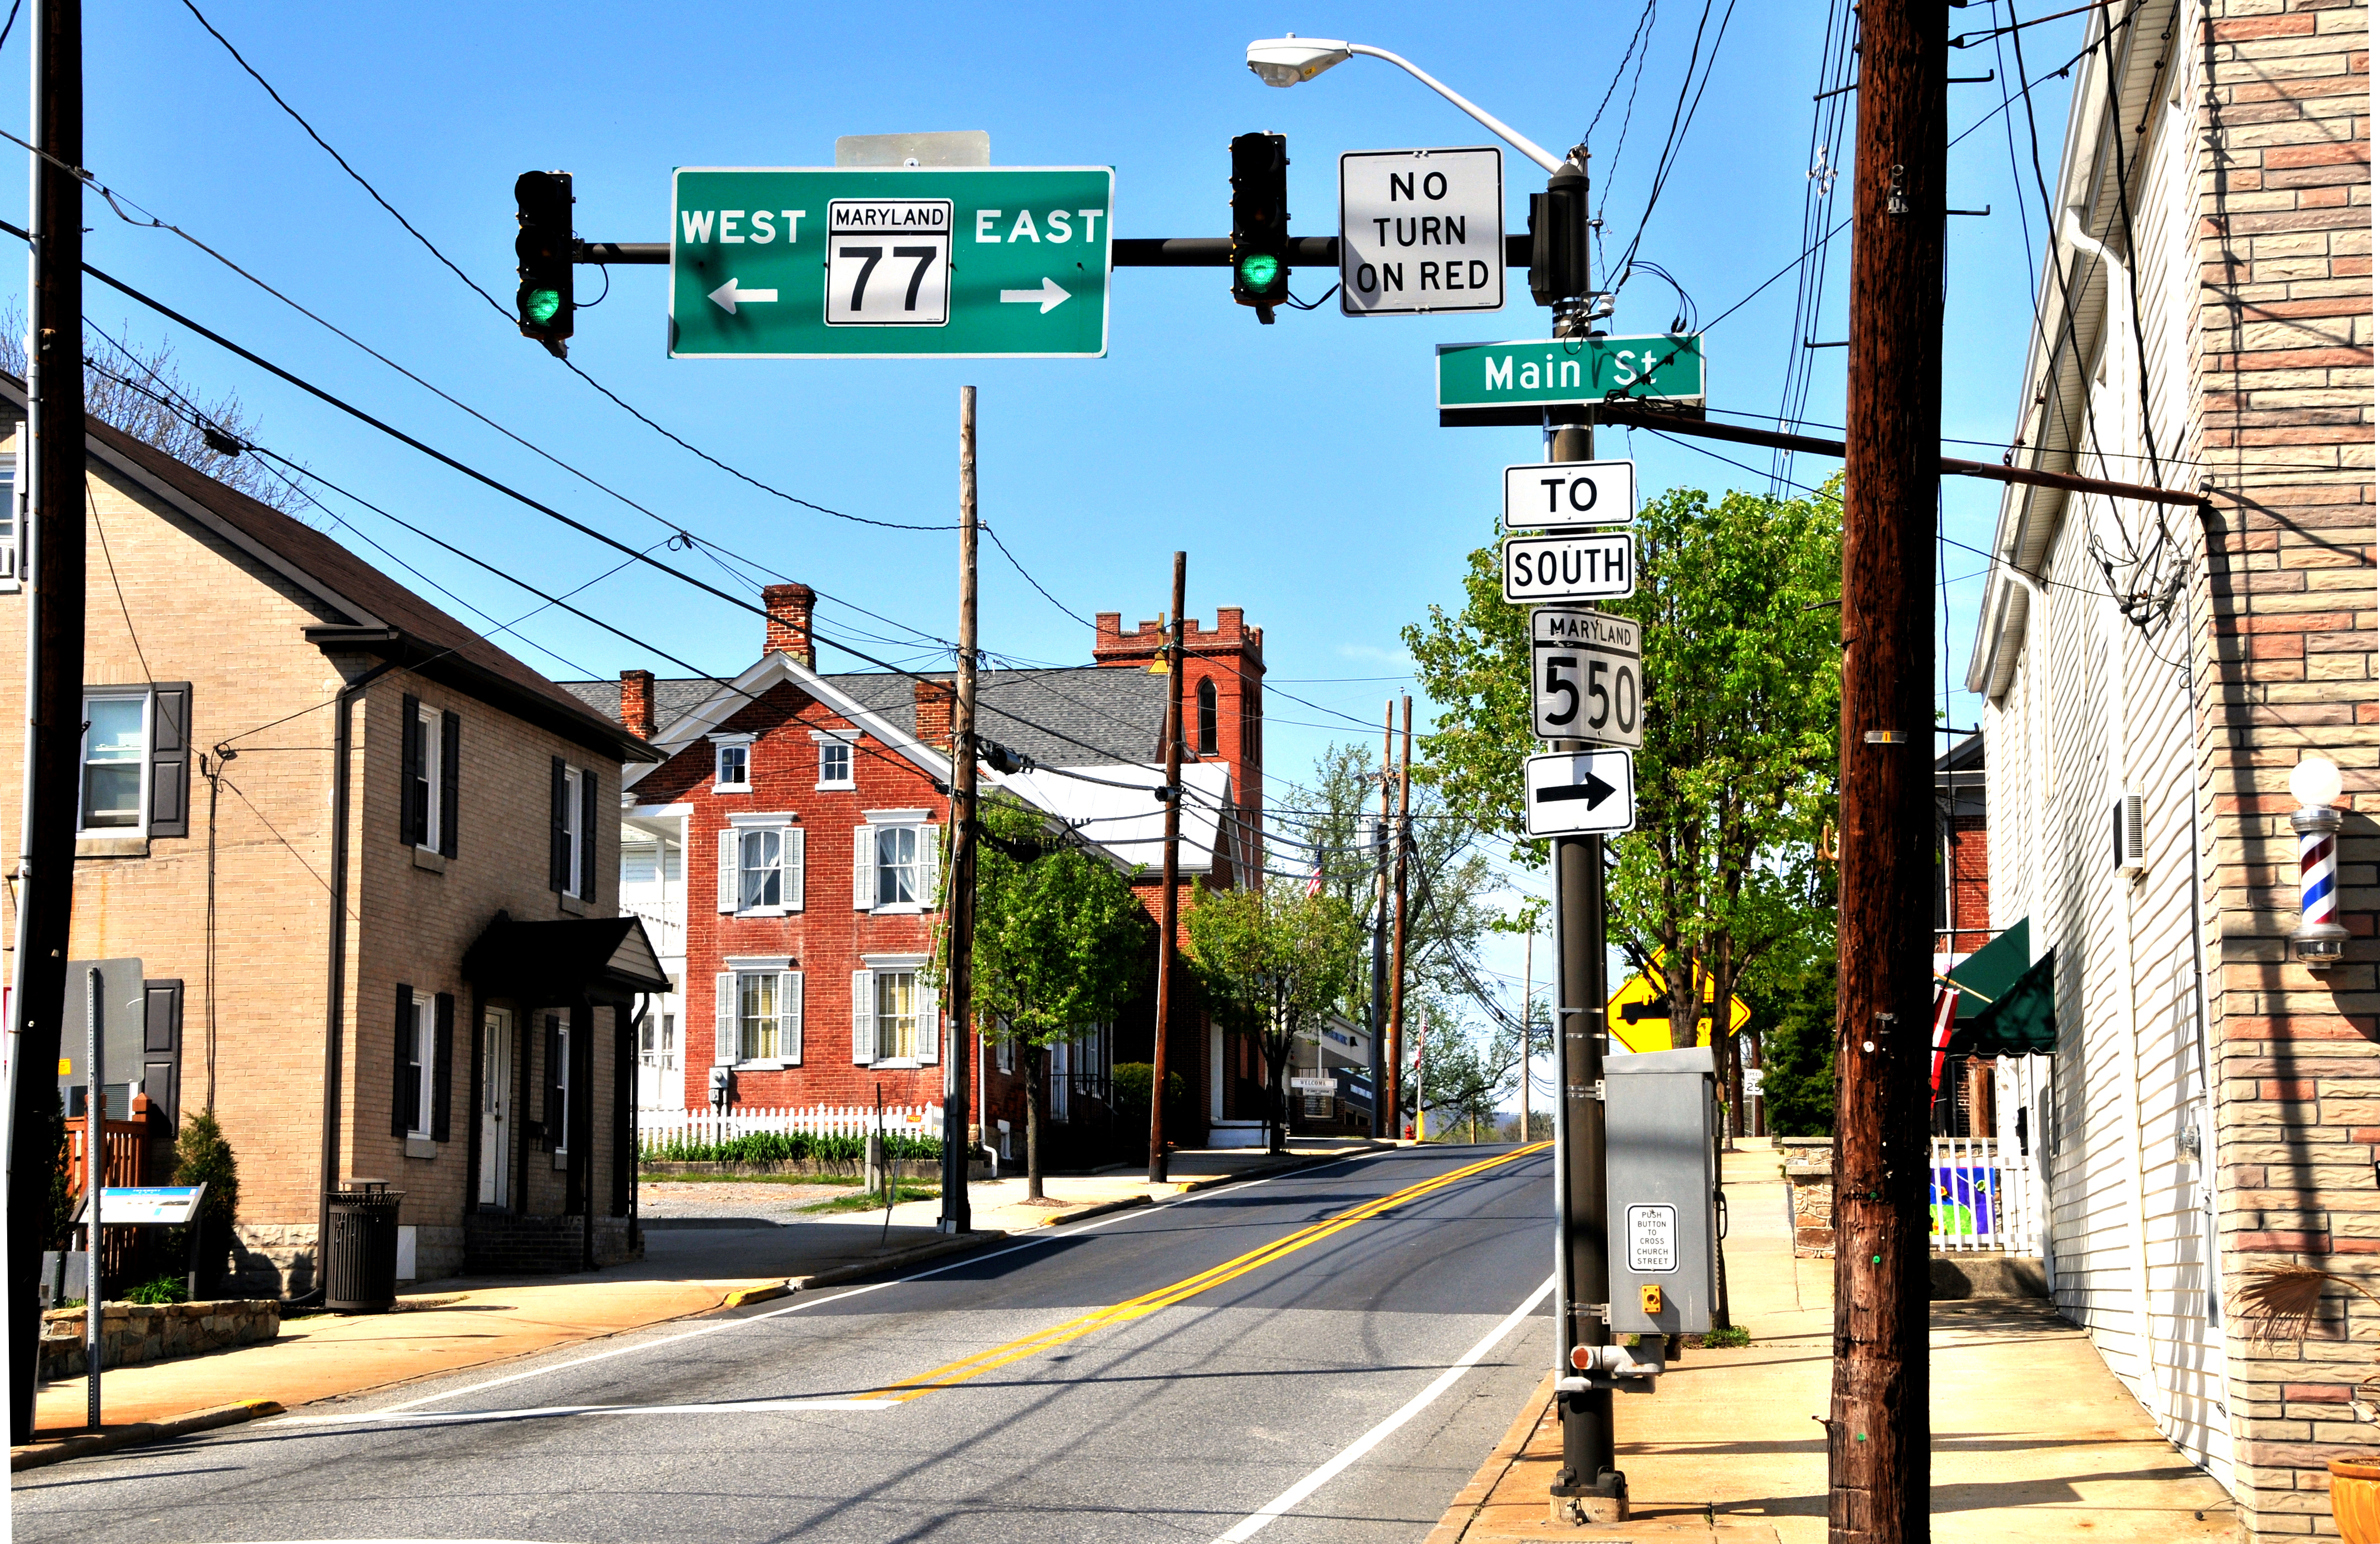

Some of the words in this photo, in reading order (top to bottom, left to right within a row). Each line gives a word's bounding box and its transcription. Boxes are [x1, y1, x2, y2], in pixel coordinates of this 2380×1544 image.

[1390, 172, 1448, 202] NO
[682, 210, 806, 244] WEST
[836, 208, 944, 226] MARYLAND
[975, 209, 1103, 243] EAST
[1373, 215, 1466, 247] TURN
[839, 246, 937, 311] 77
[1357, 263, 1403, 293] ON
[1420, 260, 1489, 290] RED
[1485, 354, 1581, 390] Main
[1613, 349, 1657, 385] St
[1541, 477, 1597, 512] TO
[1514, 547, 1623, 587] SOUTH
[1550, 618, 1631, 646] MARYLAND
[1545, 656, 1636, 734] 550
[1746, 1082, 1761, 1092] 25
